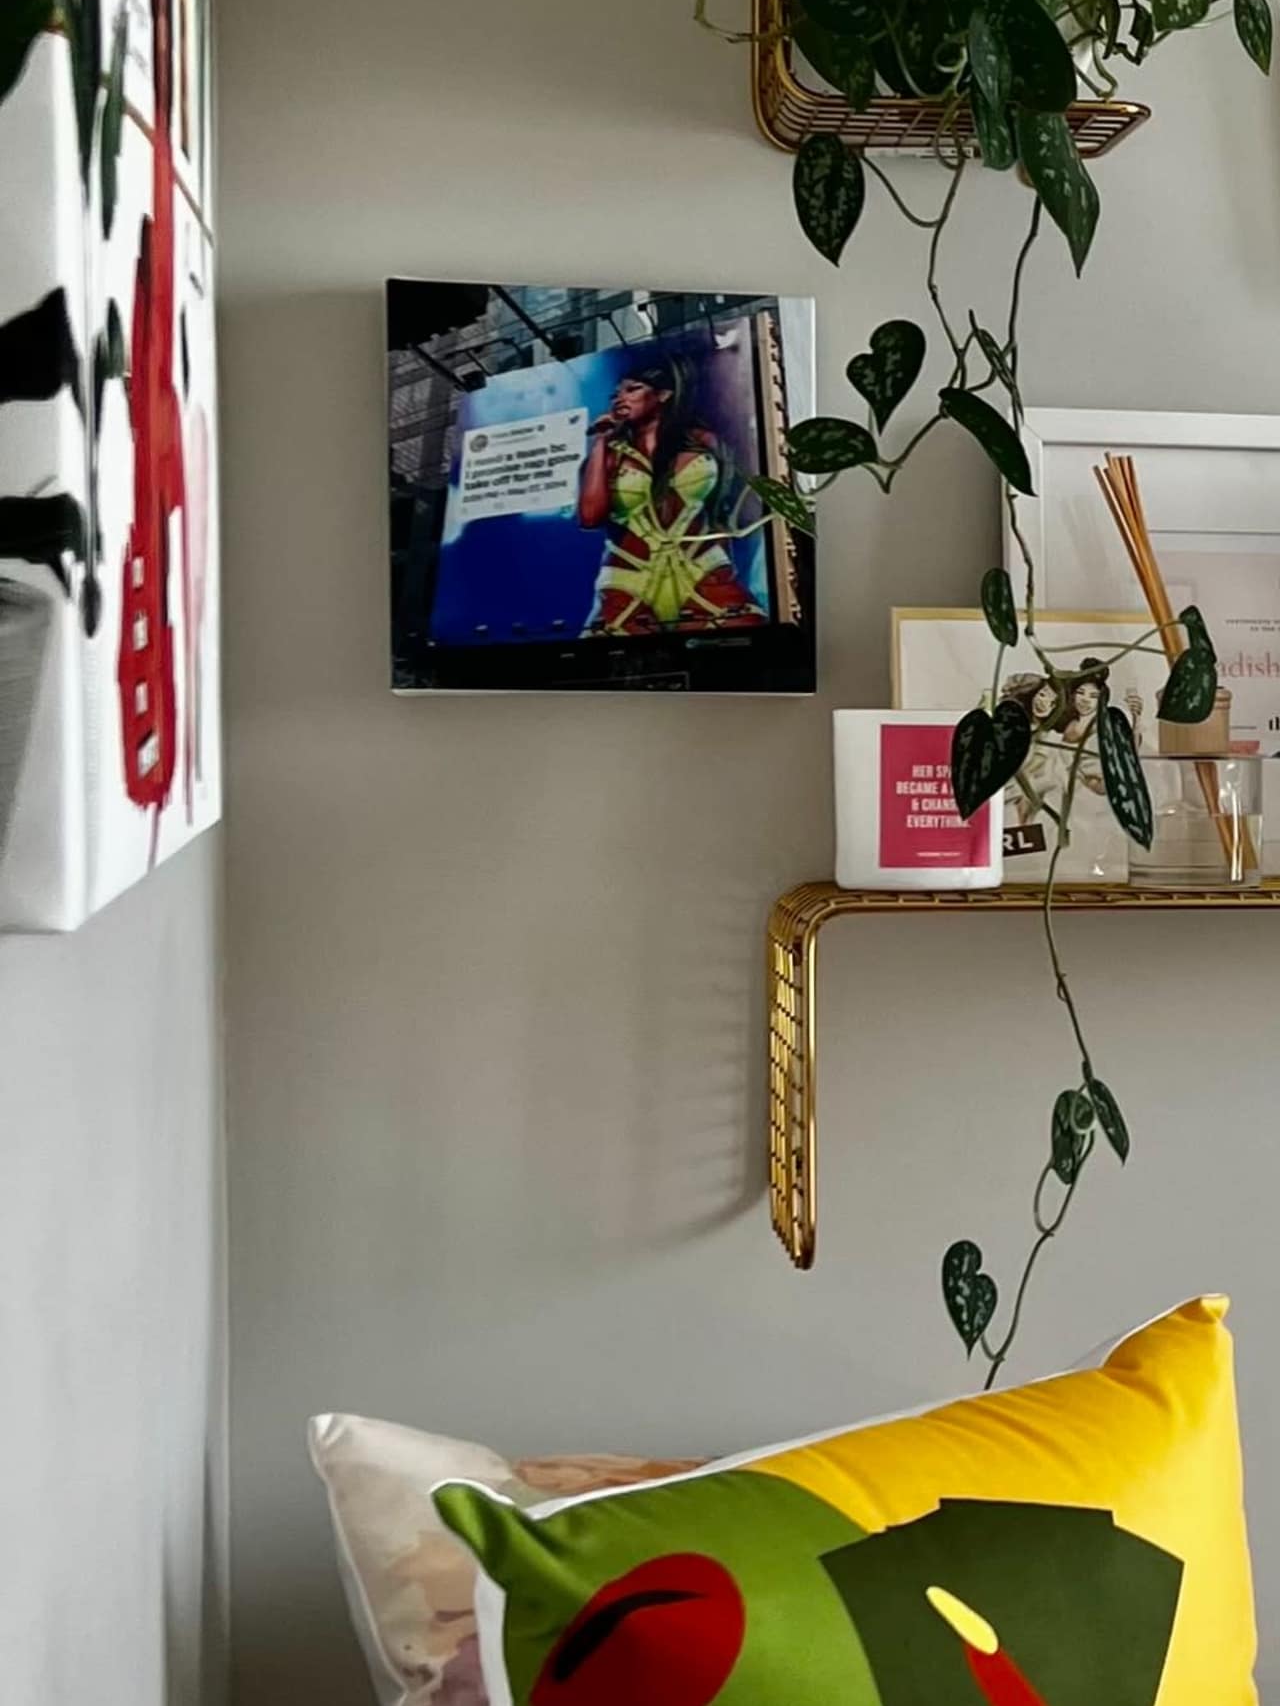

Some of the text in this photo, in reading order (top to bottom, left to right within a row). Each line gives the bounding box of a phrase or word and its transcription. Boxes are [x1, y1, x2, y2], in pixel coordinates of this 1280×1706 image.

[912, 765, 933, 778] HER
[896, 781, 939, 795] BECAME
[1003, 831, 1034, 851] RL
